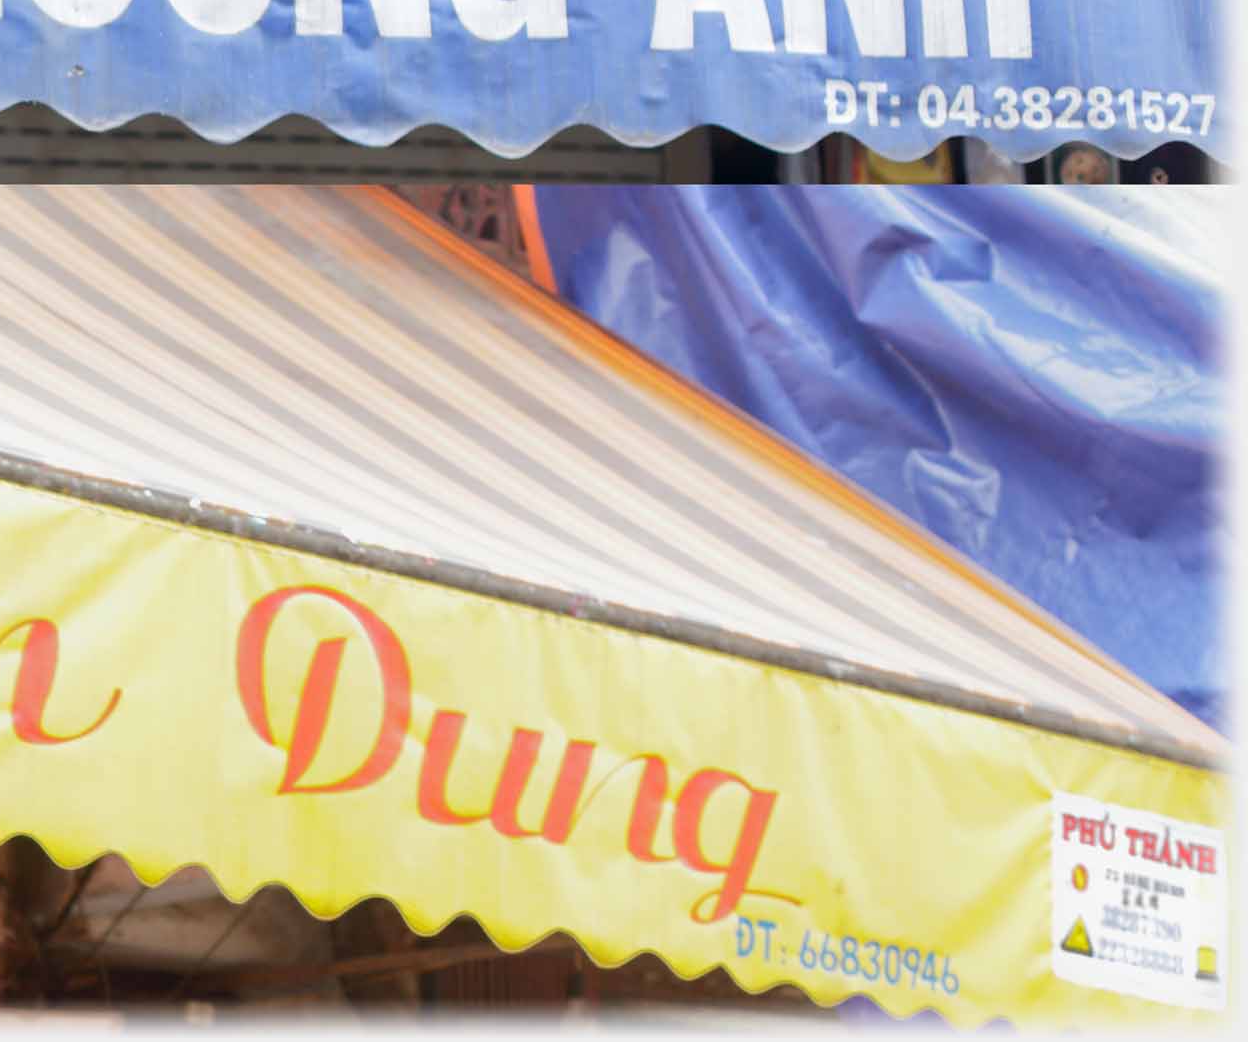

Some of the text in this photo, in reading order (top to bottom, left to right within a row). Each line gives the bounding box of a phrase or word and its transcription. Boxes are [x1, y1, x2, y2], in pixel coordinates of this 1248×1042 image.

[824, 78, 1218, 135] ĐT: 04.38281527
[235, 585, 805, 926] Dung
[736, 915, 961, 995] ĐT: 66830946
